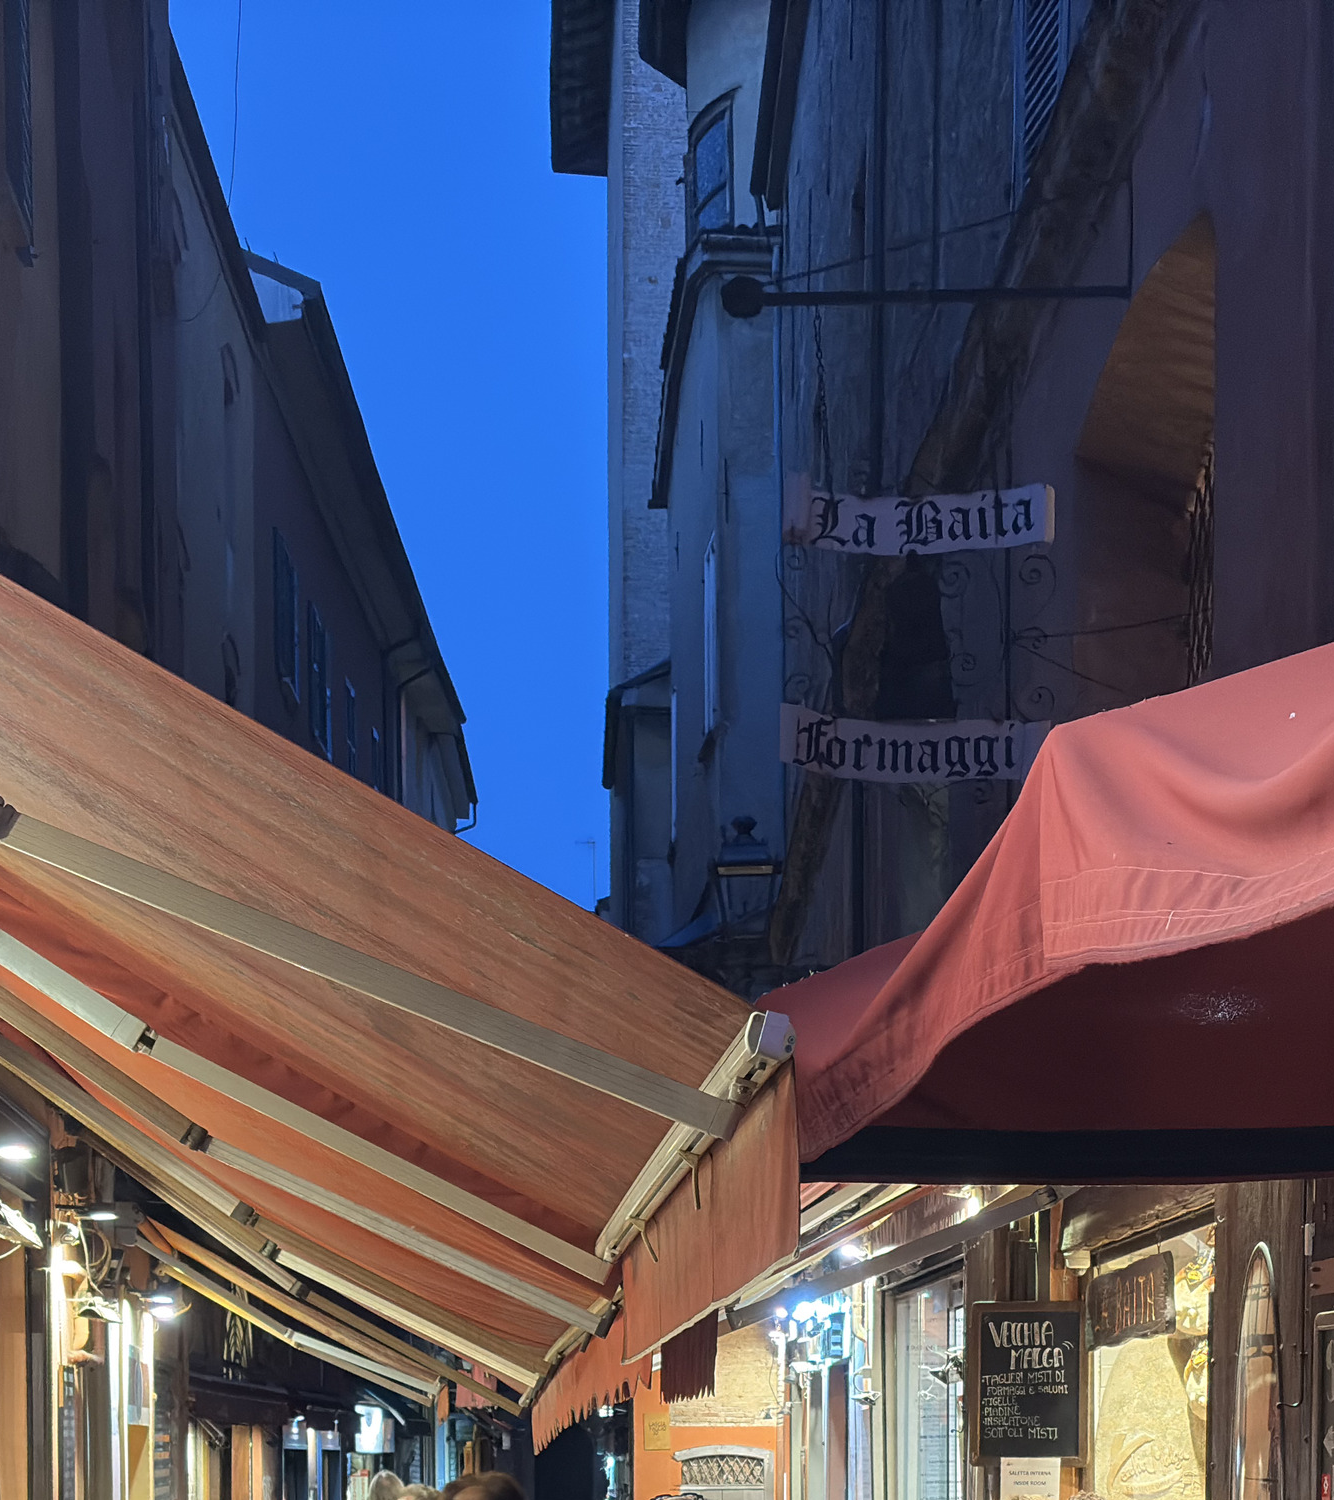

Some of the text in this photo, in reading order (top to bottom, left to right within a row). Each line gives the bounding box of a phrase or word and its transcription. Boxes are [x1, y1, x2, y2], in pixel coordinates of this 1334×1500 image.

[811, 494, 1035, 556] La Baita
[793, 715, 1015, 778] Formaggi
[988, 1320, 1055, 1348] VECCHIA
[1009, 1347, 1065, 1370] MALGA
[1027, 1370, 1053, 1385] MISTI
[1055, 1369, 1066, 1383] DI
[987, 1385, 1027, 1396] FORMAGGI
[1038, 1384, 1069, 1395] SALUMI
[1028, 1427, 1059, 1440] MISTI
